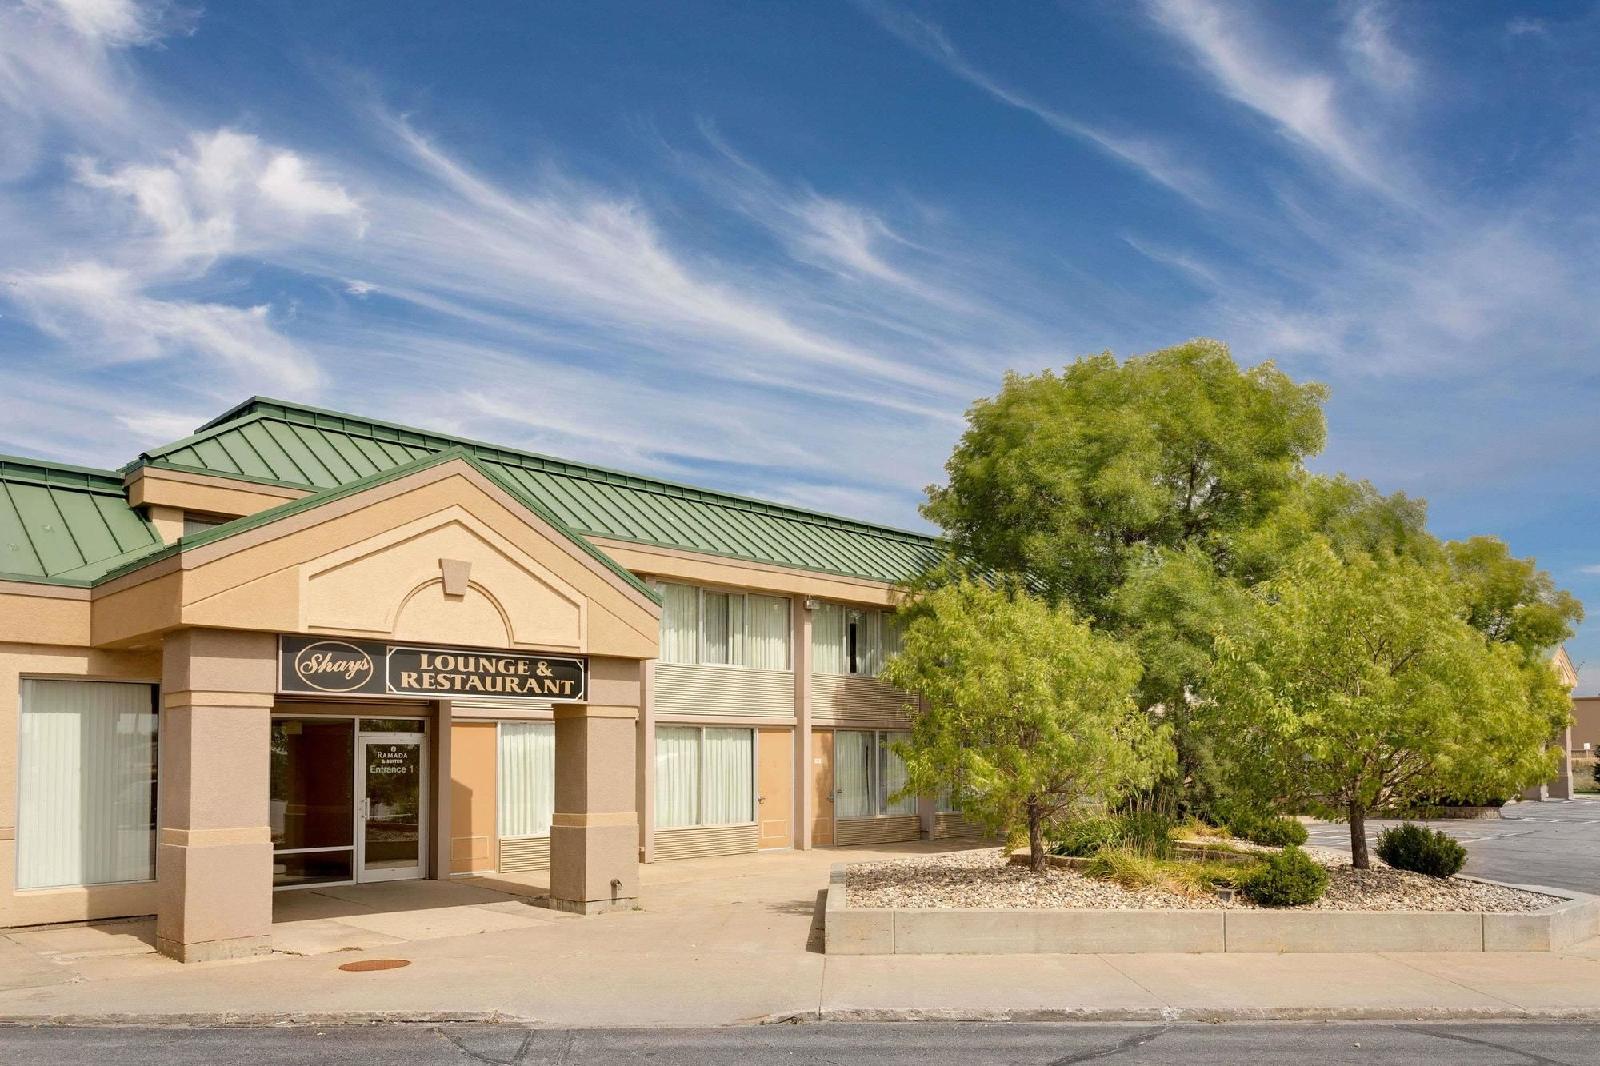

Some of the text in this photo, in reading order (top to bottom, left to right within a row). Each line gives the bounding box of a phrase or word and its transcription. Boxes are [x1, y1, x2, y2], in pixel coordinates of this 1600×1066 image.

[420, 653, 553, 677] LOUNGE &
[400, 671, 574, 695] RESTAURANT
[377, 751, 408, 759] RAMADA
[369, 765, 414, 774] Entrance 1
